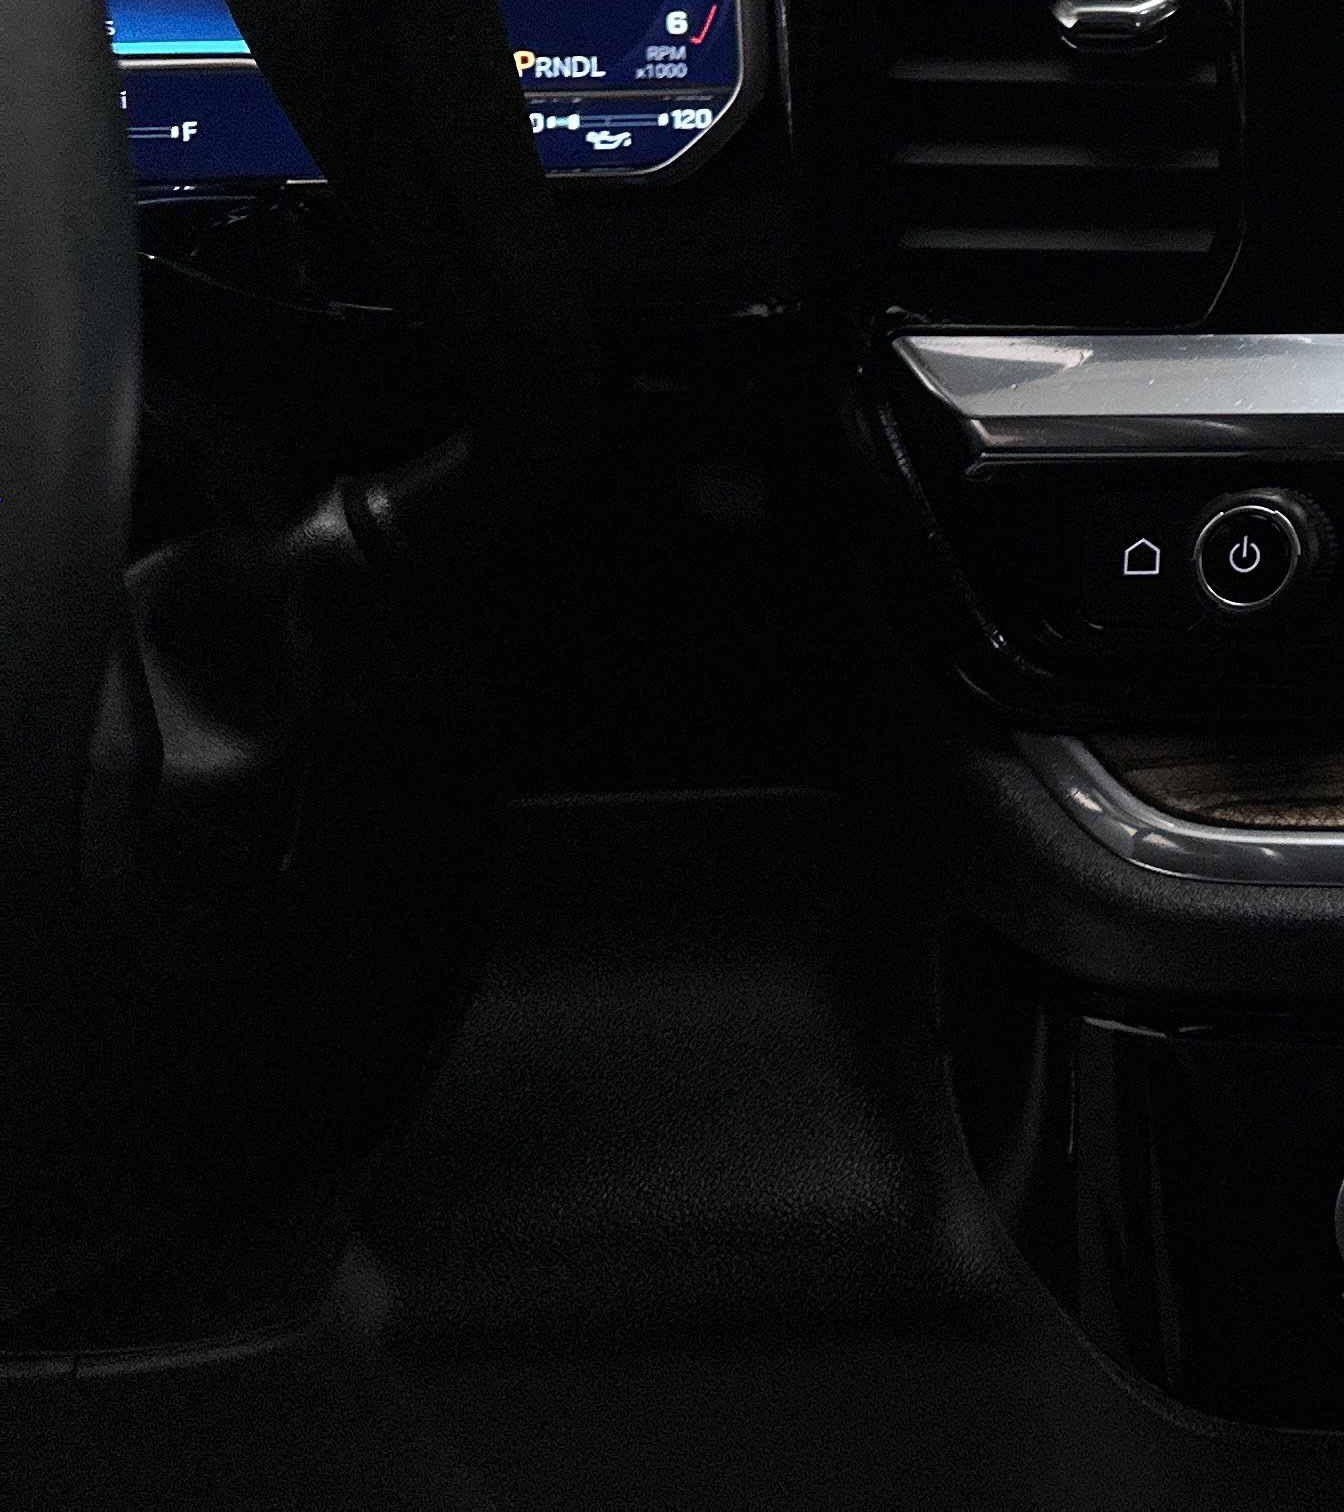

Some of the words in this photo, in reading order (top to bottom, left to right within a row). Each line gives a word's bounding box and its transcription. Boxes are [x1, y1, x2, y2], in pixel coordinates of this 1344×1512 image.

[665, 10, 689, 35] 6
[646, 45, 687, 62] RPM
[635, 62, 688, 79] x1000
[670, 108, 713, 130] 120
[182, 120, 198, 142] F
